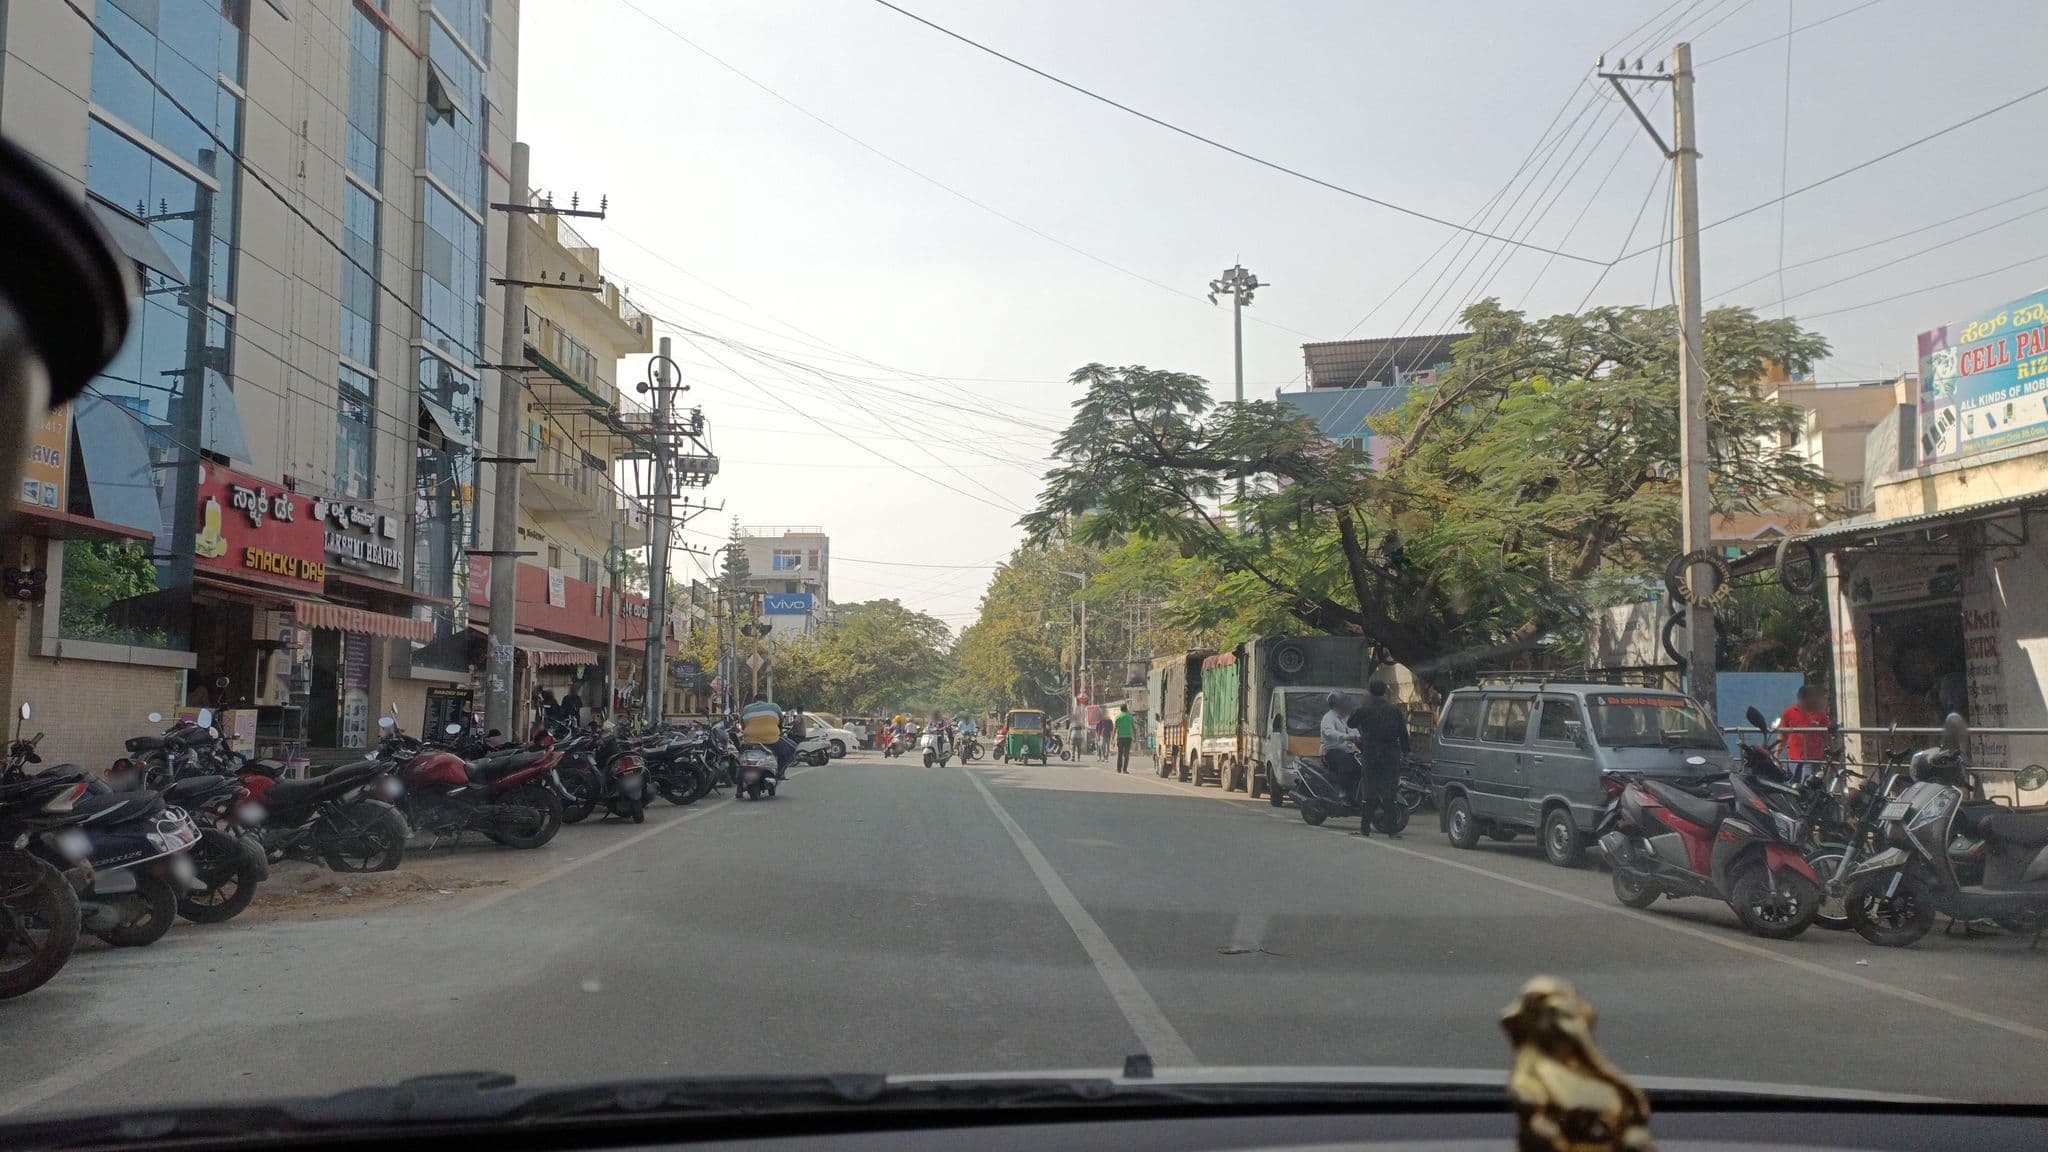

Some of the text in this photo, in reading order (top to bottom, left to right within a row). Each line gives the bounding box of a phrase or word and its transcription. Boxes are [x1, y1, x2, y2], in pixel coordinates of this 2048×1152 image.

[1960, 338, 2010, 377] CELL
[1961, 400, 1976, 411] ALL
[1978, 389, 2006, 406] KINDS
[2008, 386, 2021, 398] OF
[246, 547, 325, 582] SNACKY DAY
[366, 542, 403, 570] HEAVENS
